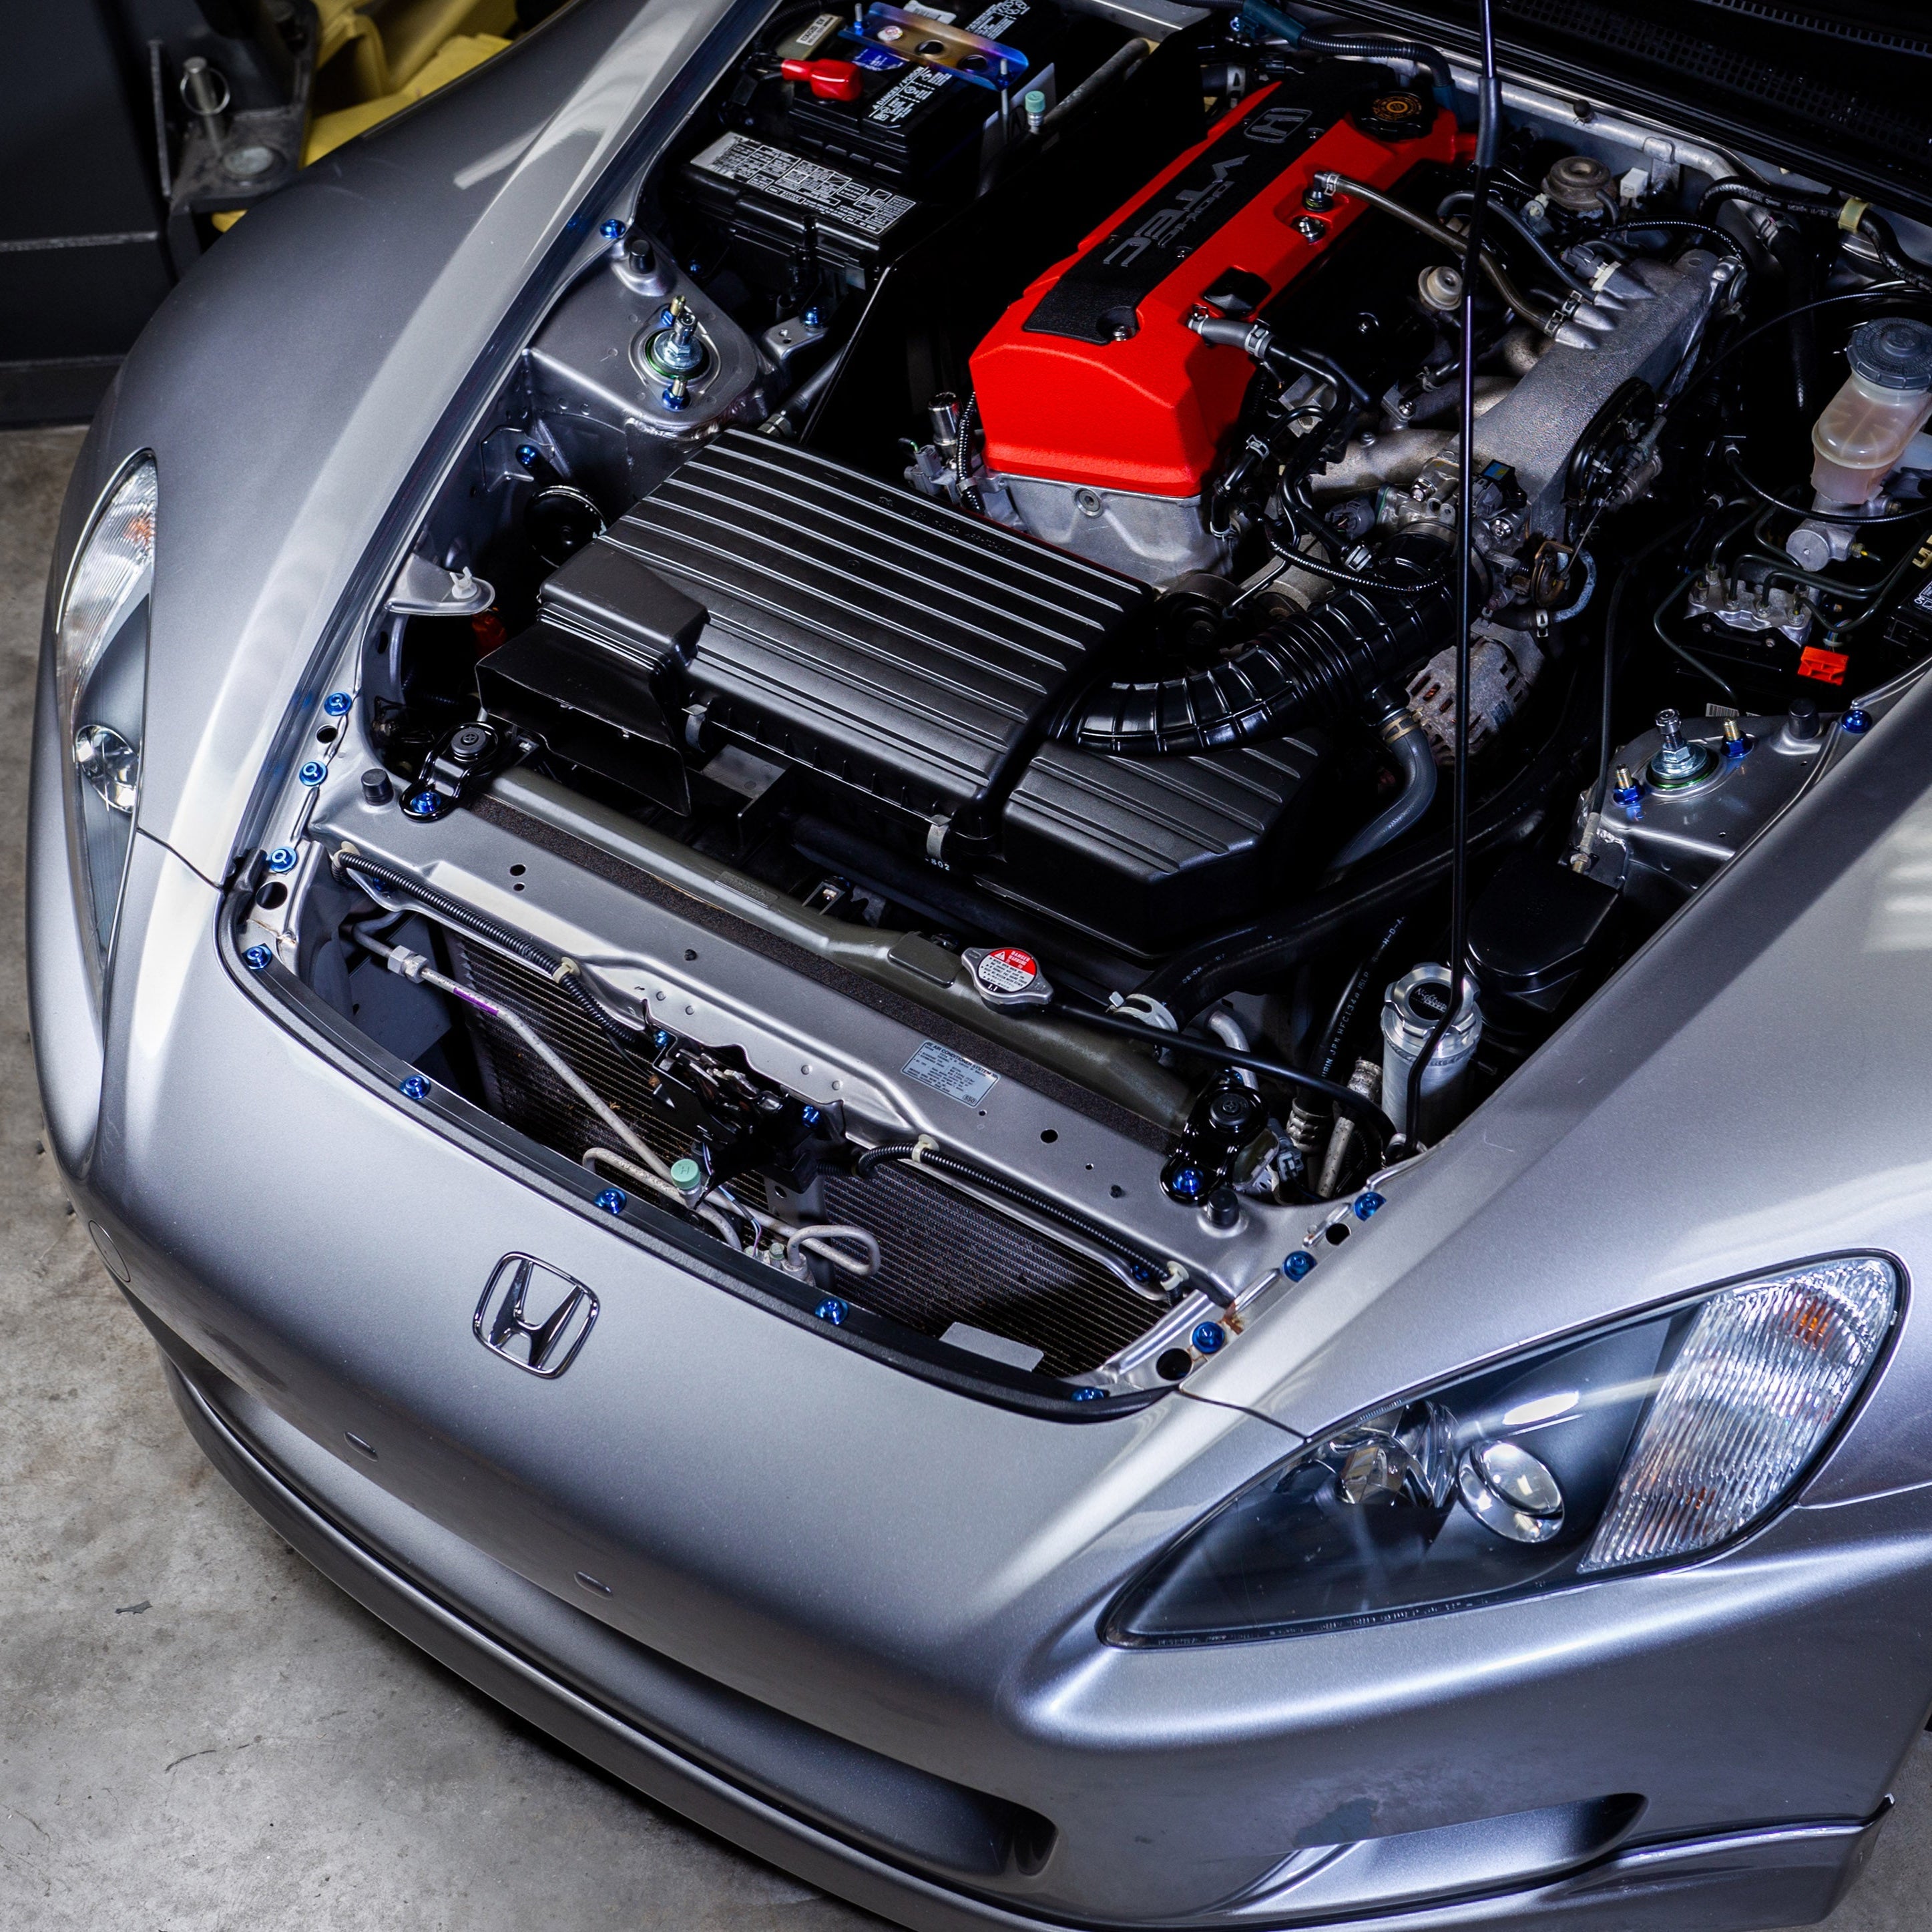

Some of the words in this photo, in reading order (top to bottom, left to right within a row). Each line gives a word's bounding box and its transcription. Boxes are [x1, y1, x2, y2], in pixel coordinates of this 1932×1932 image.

[876, 85, 901, 105] DANGER
[902, 66, 925, 83] POISON
[1103, 154, 1250, 267] VTEC
[1157, 181, 1235, 248] DOHC
[1008, 955, 1027, 966] WARNING
[1011, 951, 1031, 962] DANGER
[988, 983, 998, 991] 1.1
[941, 1049, 972, 1066] CONDITIONER
[972, 1064, 991, 1075] SYSTEM
